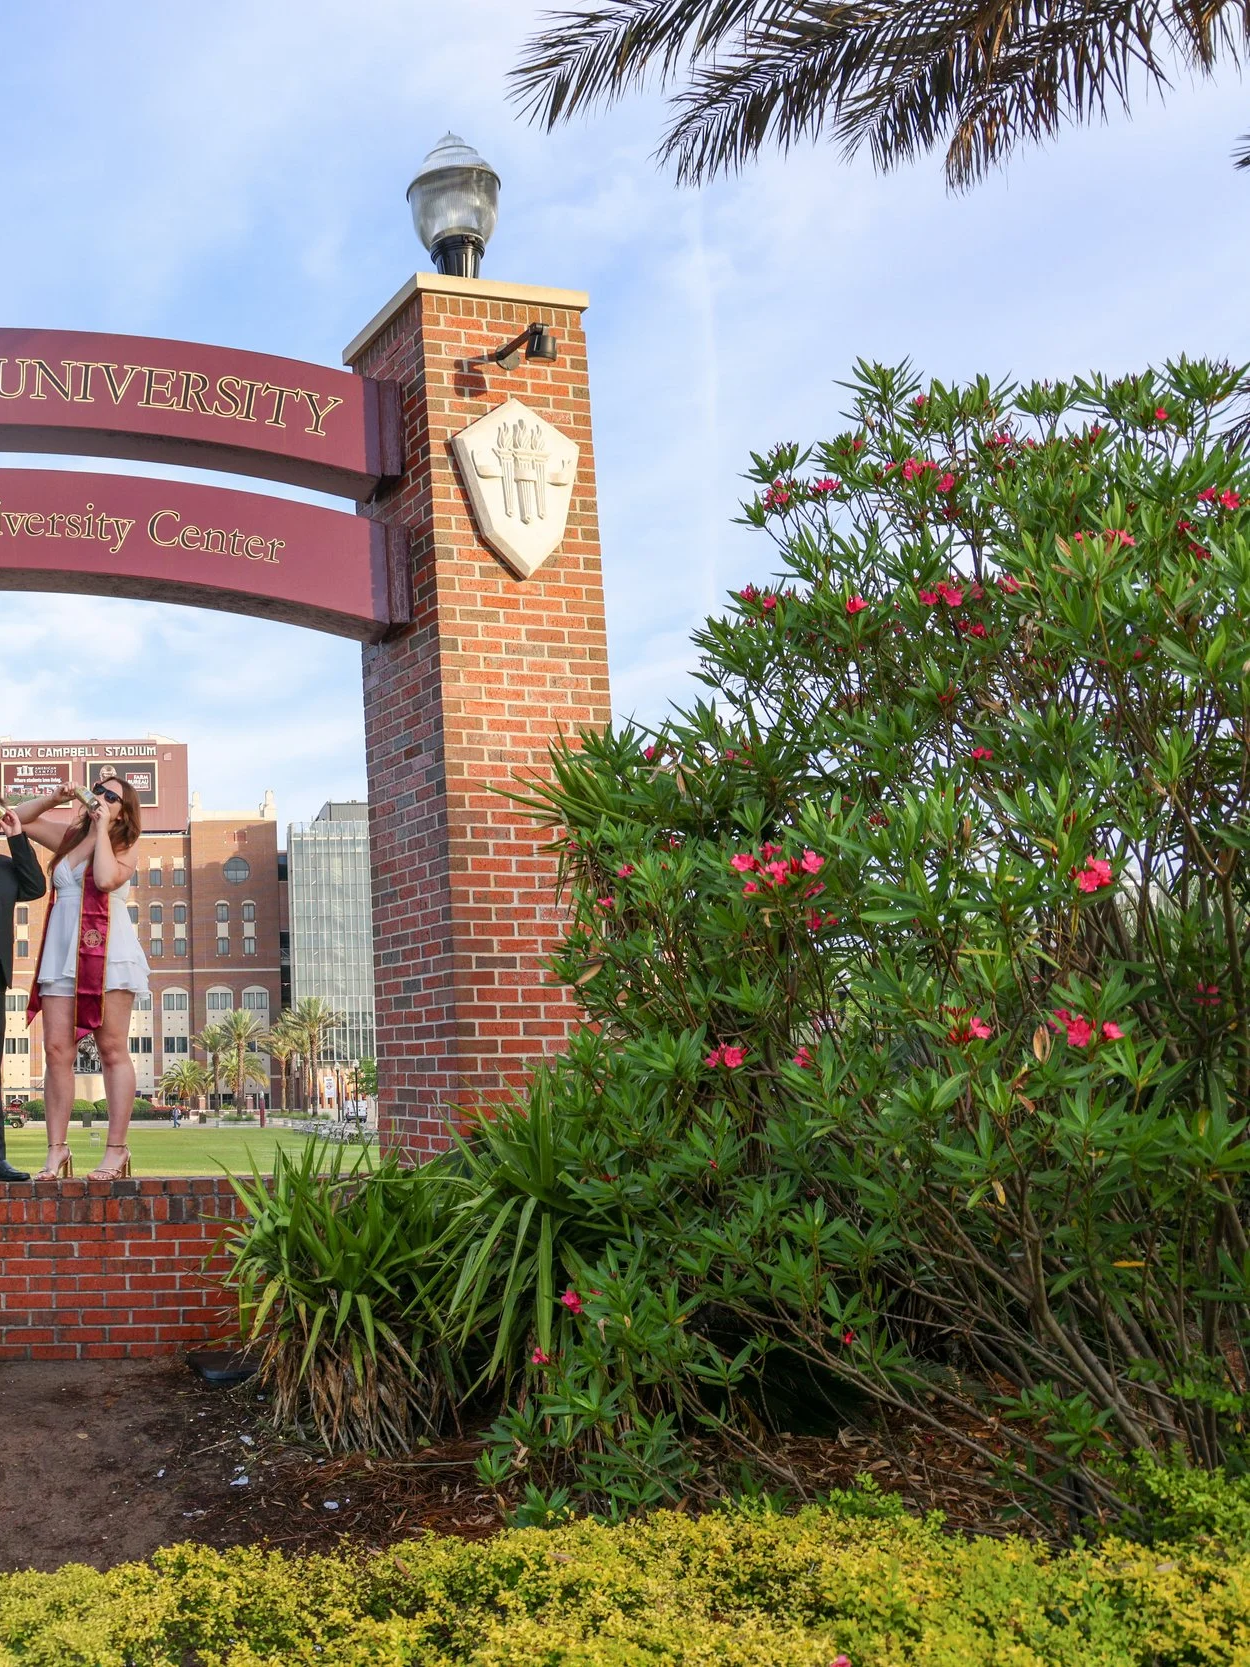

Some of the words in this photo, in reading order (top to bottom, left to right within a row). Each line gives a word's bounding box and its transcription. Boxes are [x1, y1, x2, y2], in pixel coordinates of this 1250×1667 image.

[147, 509, 286, 564] Center
[2, 748, 32, 758] DOAK
[37, 747, 99, 757] CAMPBELL
[105, 746, 157, 756] STADIUM
